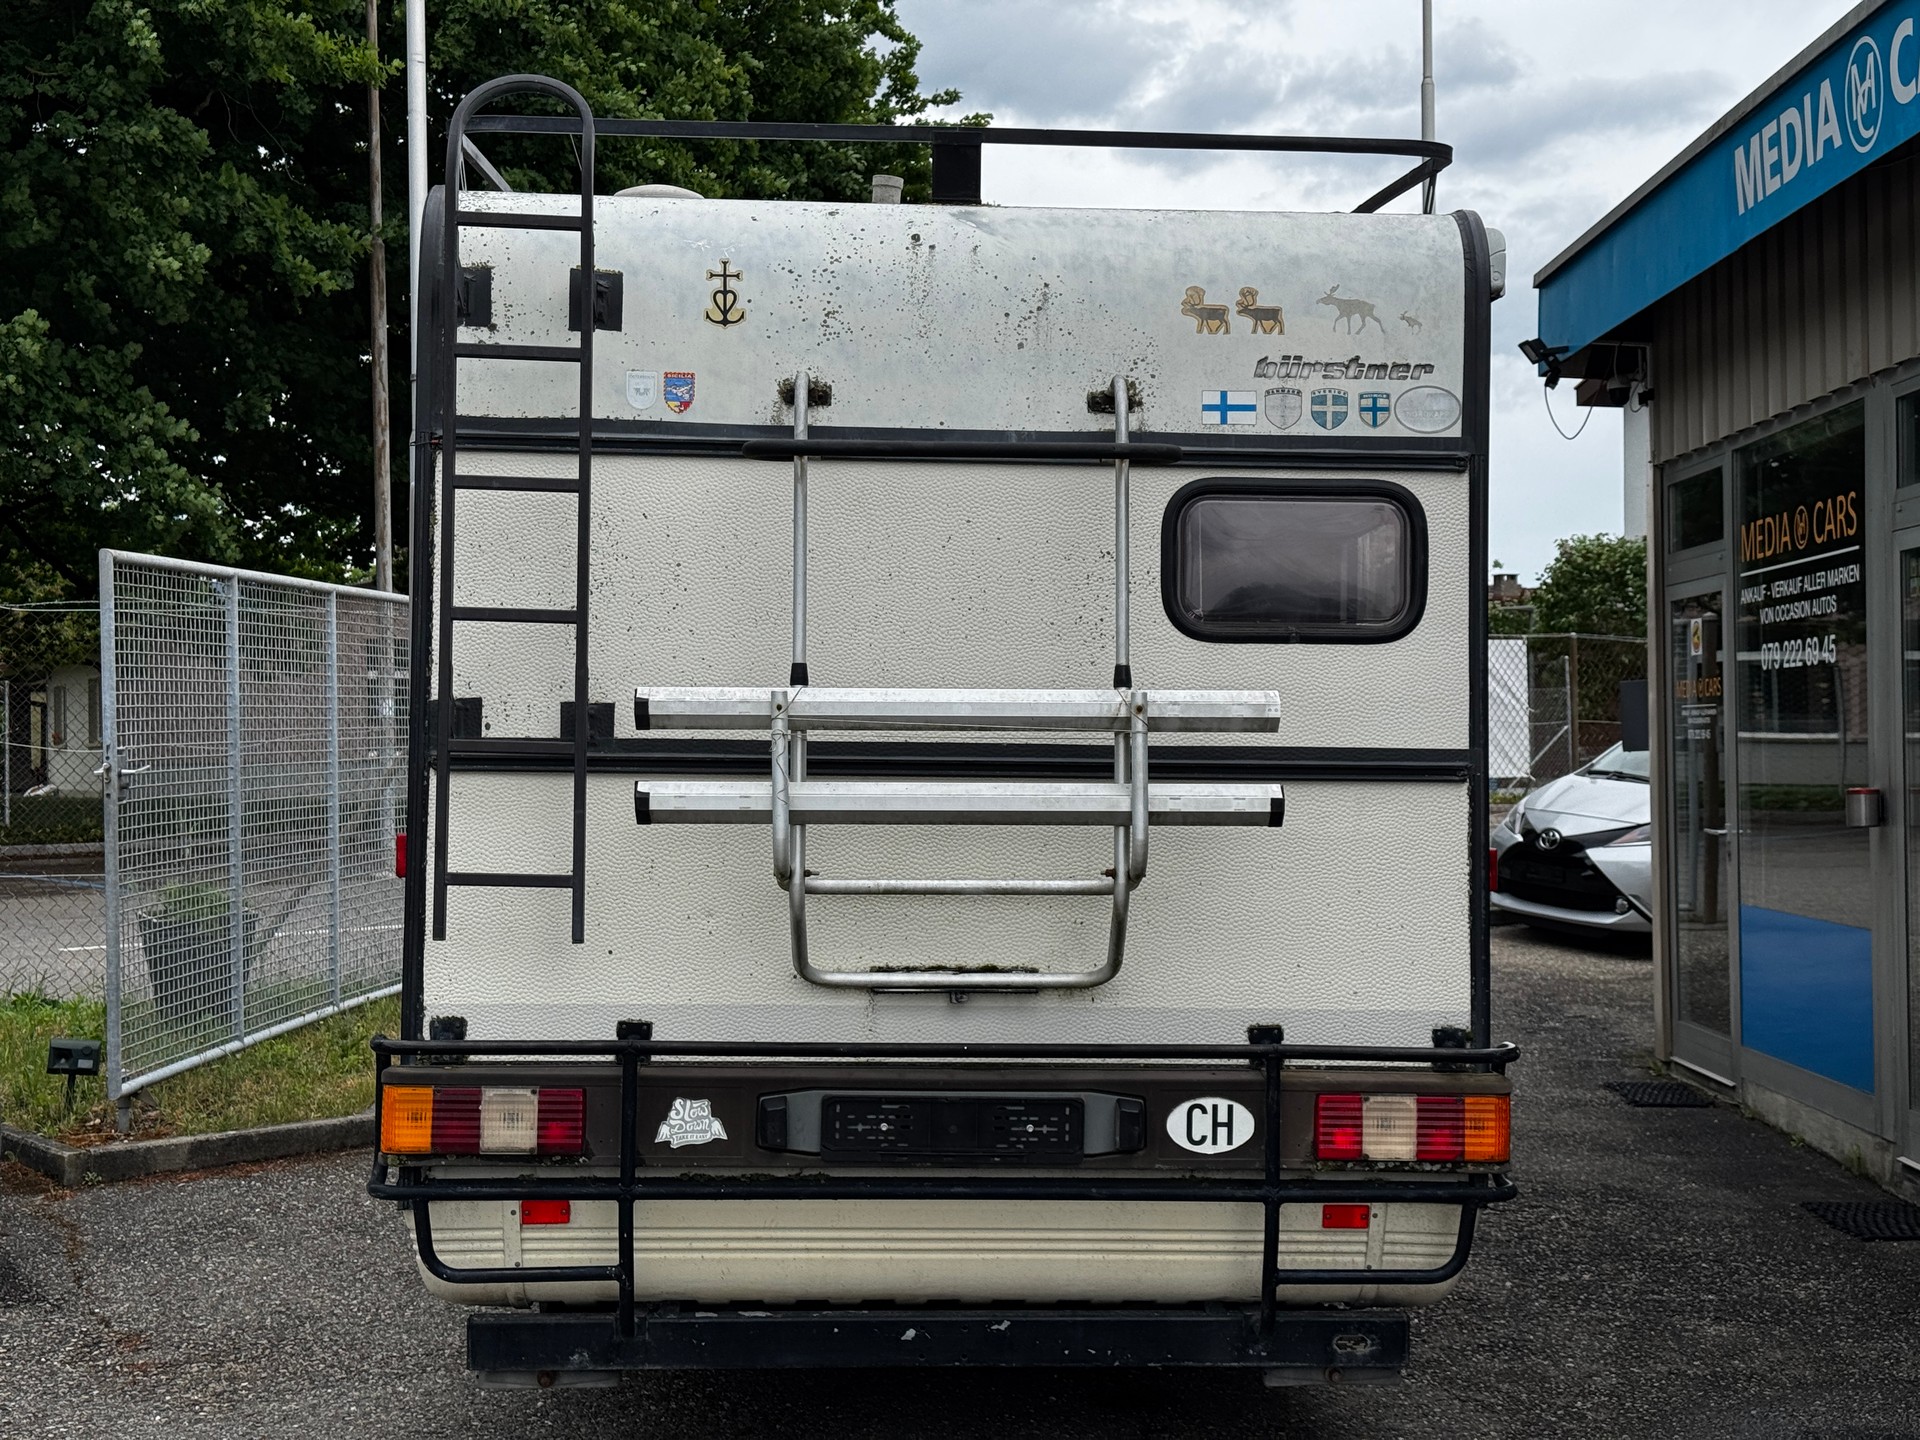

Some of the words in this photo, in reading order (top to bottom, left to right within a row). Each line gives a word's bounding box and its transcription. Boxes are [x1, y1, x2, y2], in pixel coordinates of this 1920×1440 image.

[1734, 77, 1843, 216] MEDIA
[1889, 17, 1920, 104] C
[1253, 354, 1435, 380] bürstner
[1265, 388, 1301, 396] DANMARK
[1740, 511, 1792, 563] MEDIA
[1813, 491, 1858, 544] CARS
[1740, 584, 1767, 605] ANKAUF
[1771, 576, 1803, 598] VERKAUF
[1803, 571, 1826, 592] ALLER
[1827, 563, 1860, 588] MARKEN
[1760, 605, 1774, 625] VON
[1774, 599, 1811, 623] OCCASION
[1811, 594, 1837, 616] AUTOS
[1761, 642, 1780, 671] 079
[1783, 638, 1803, 669] 222
[1805, 636, 1819, 667] 69
[1821, 634, 1837, 664] 45
[1704, 677, 1722, 697] CARS
[1186, 1103, 1234, 1146] CH
